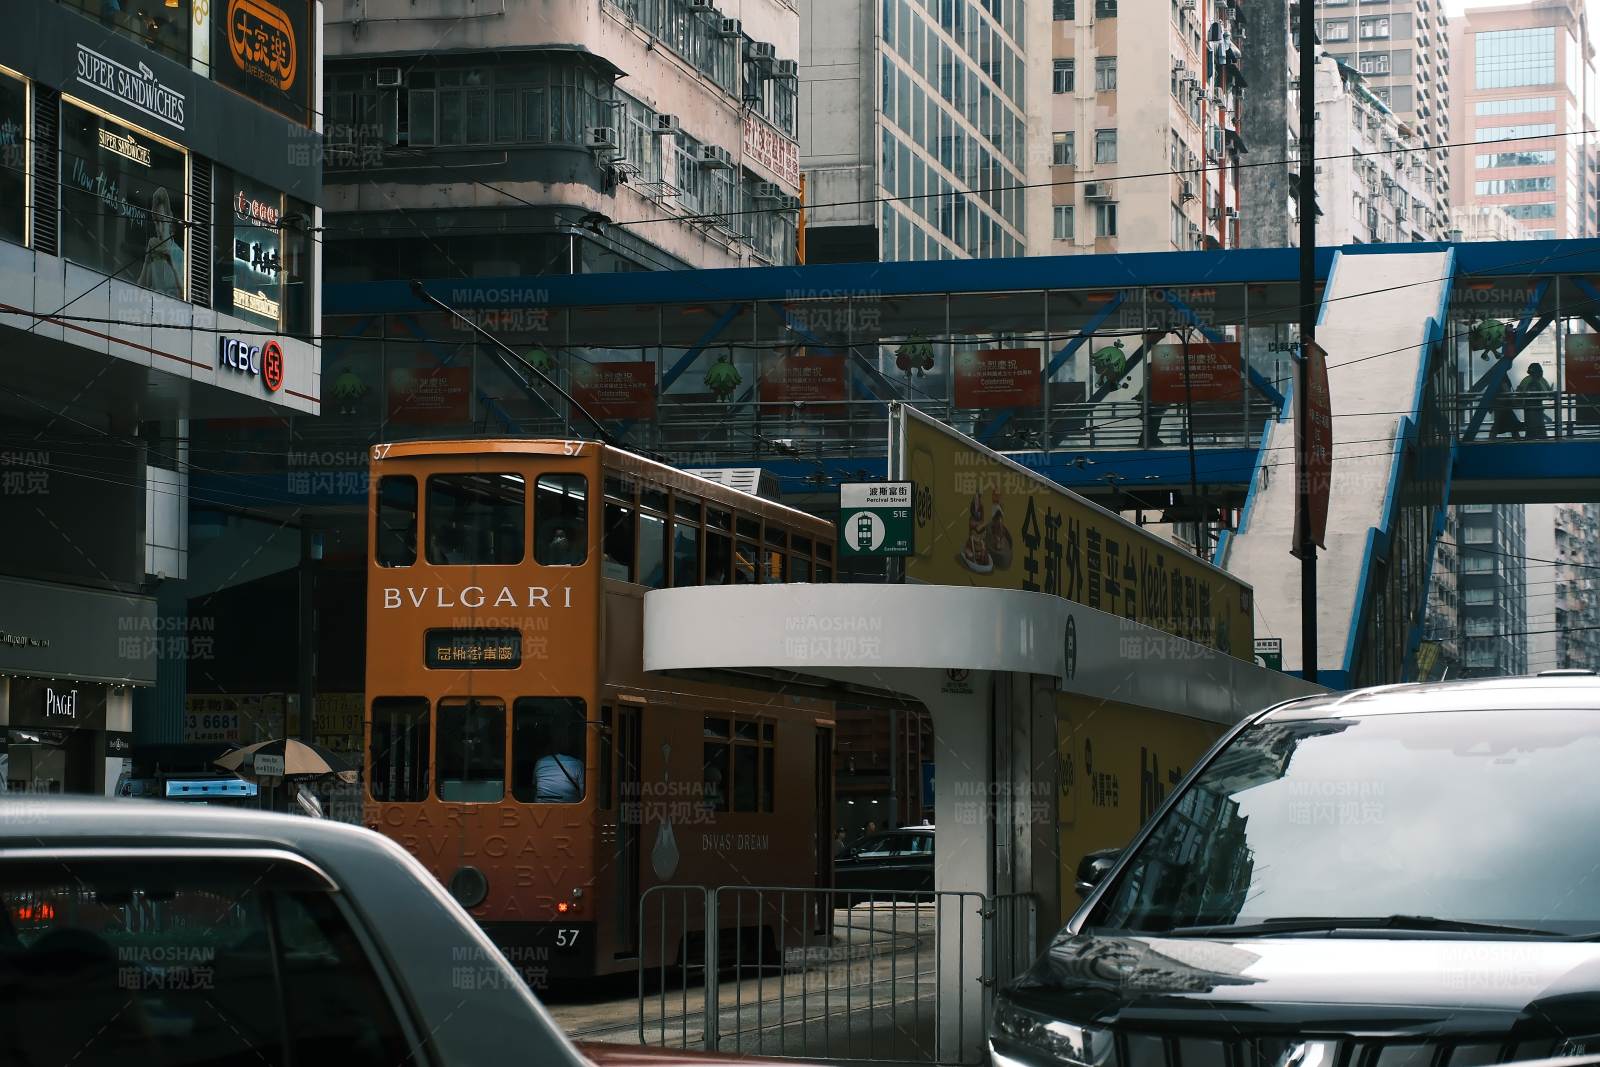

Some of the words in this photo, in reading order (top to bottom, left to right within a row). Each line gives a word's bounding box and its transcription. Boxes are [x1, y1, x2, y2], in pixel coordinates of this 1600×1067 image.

[78, 50, 115, 91] SUPER
[118, 69, 184, 124] SANDWICHES
[98, 131, 118, 150] SUPER
[117, 139, 151, 164] SANDWICHES
[221, 336, 259, 375] ICBC
[374, 444, 392, 460] 57
[564, 441, 584, 456] 57
[869, 486, 907, 496] 波斯富街
[893, 510, 908, 518] 51E
[383, 586, 571, 609] BVLGARI
[46, 687, 78, 719] PIAGET
[203, 714, 237, 728] 6681
[738, 834, 768, 850] DREAM
[556, 929, 580, 947] 57
